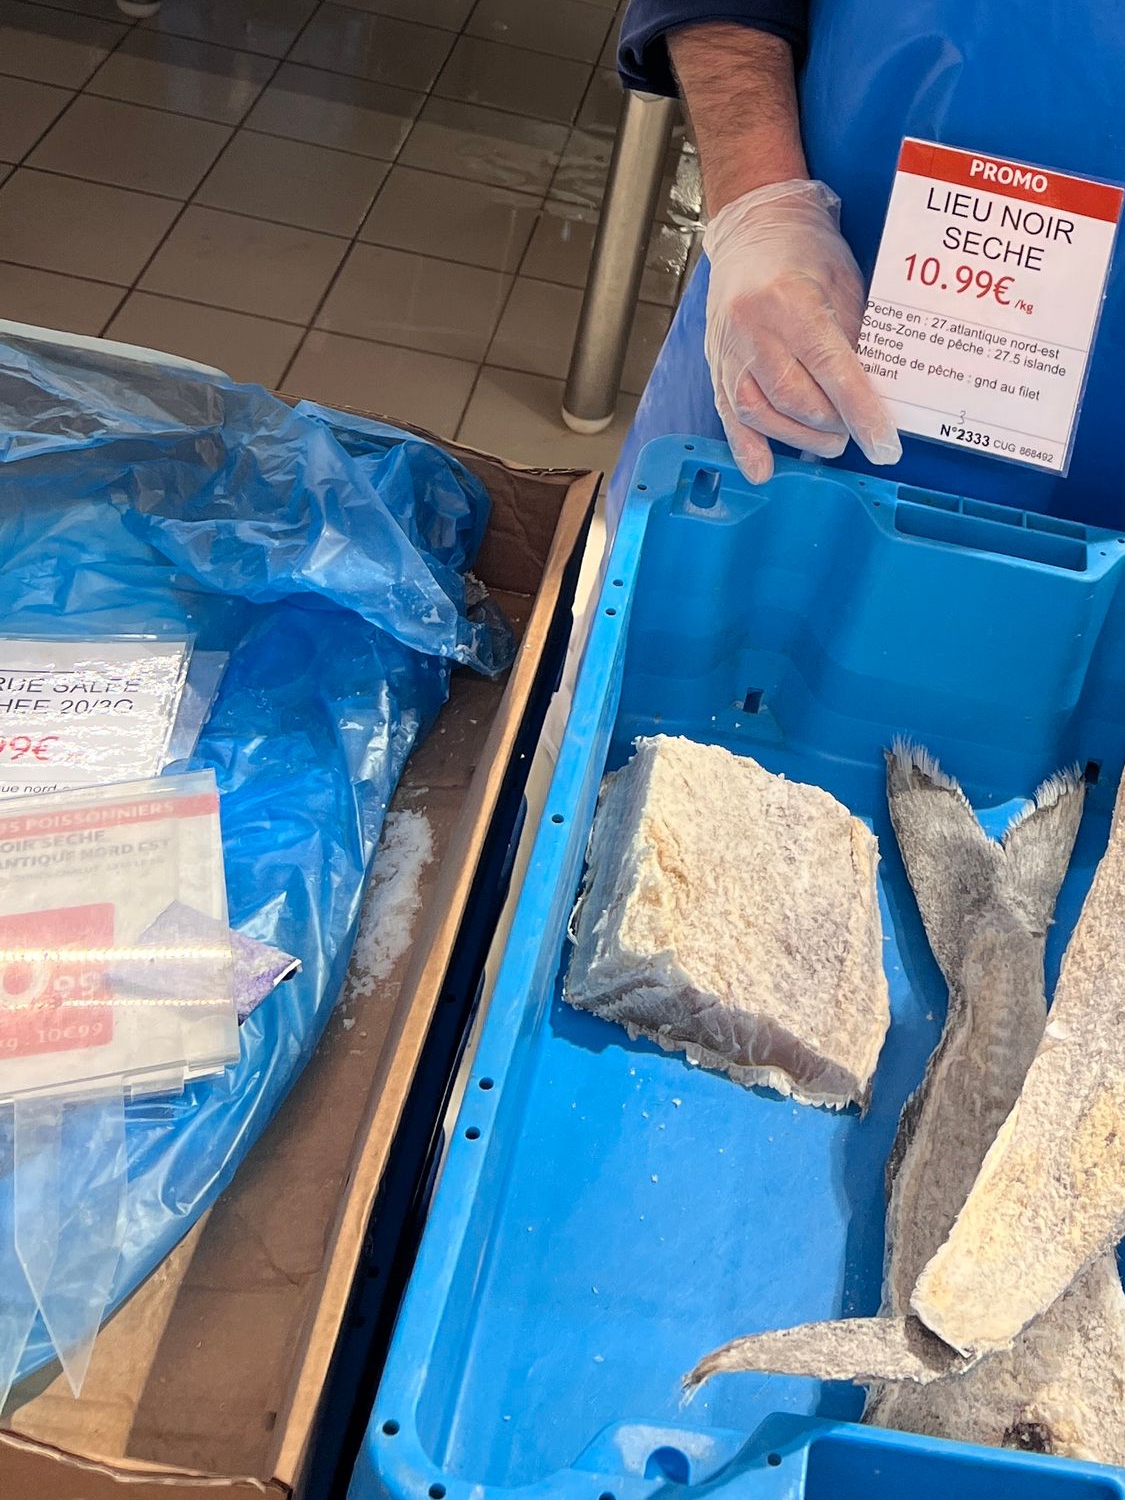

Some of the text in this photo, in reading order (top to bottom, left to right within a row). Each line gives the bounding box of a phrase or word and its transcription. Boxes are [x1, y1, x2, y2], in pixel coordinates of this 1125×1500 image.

[969, 158, 1049, 193] PROMO
[926, 187, 1075, 244] LIEU NOIR
[943, 226, 1044, 271] SECHE
[904, 253, 1016, 306] 10.99€
[859, 331, 903, 350] et feroe
[862, 315, 926, 340] Sous-Zone
[930, 334, 944, 345] de
[947, 339, 984, 355] pêche
[1024, 356, 1066, 377] islande
[865, 301, 902, 319] Peche
[906, 313, 921, 323] en
[1010, 340, 1060, 360] nord-est
[857, 344, 1040, 401] Méthode de pêche gnd au filet
[940, 423, 991, 448] N°2333
[993, 439, 1016, 453] CUG
[25, 802, 175, 831] POISSONNIERS
[40, 831, 105, 848] SECHE
